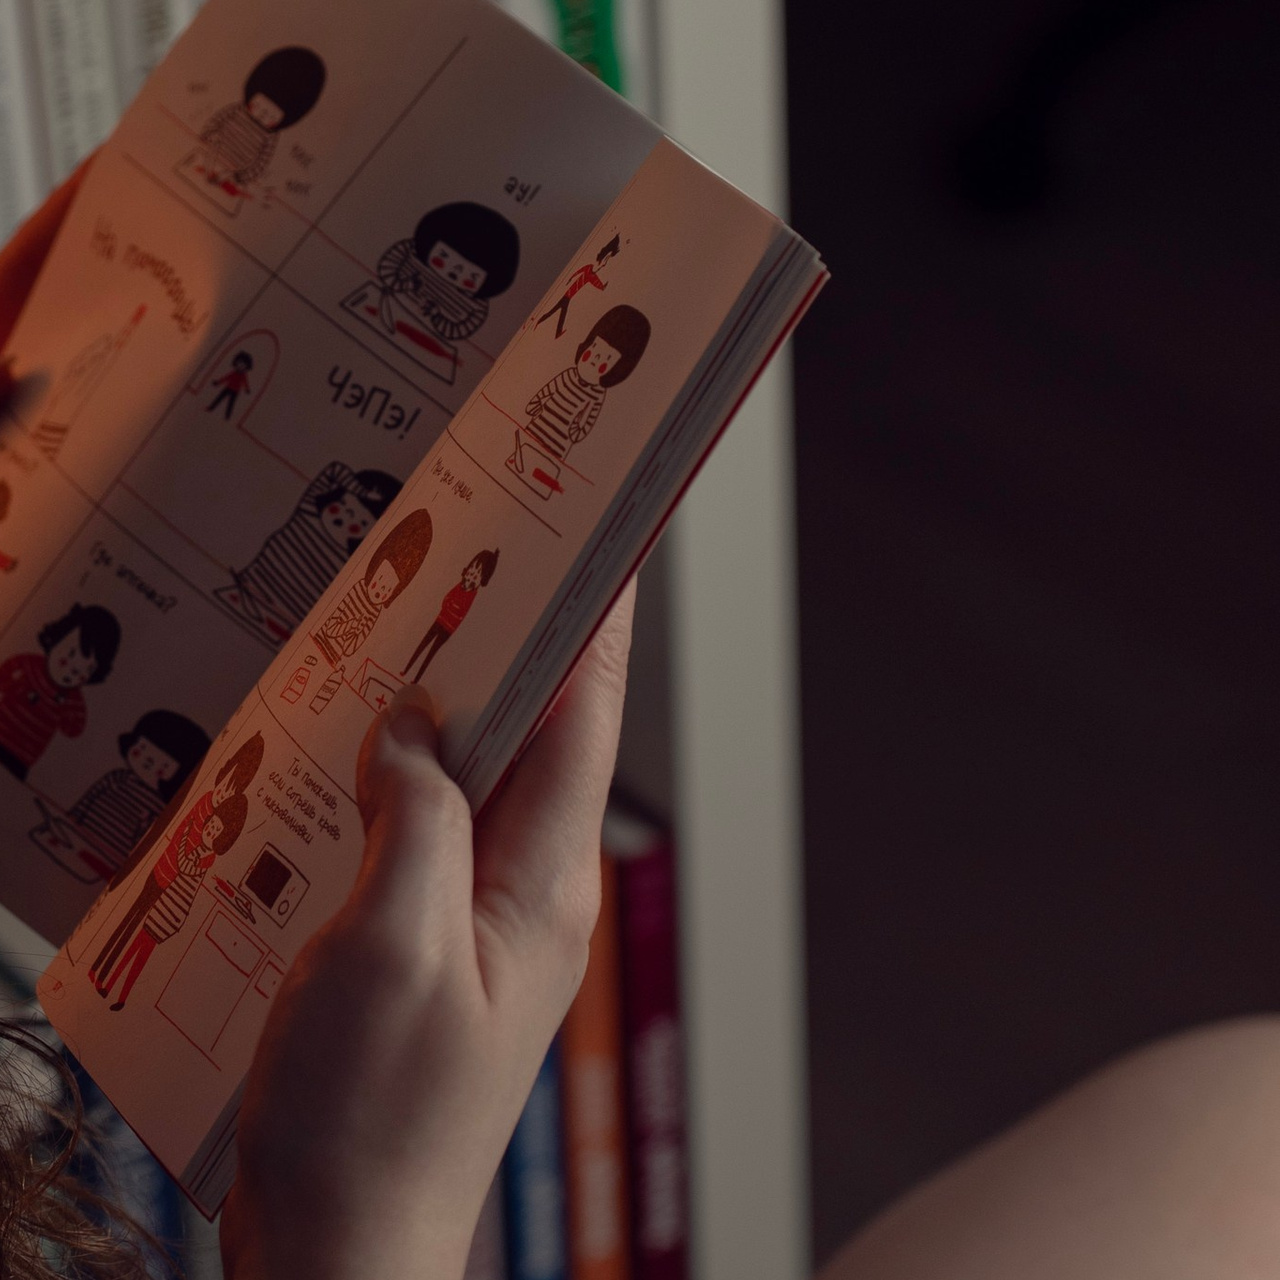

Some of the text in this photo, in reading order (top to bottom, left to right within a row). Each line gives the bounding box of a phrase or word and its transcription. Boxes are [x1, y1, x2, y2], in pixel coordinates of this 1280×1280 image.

[256, 787, 314, 845] с микроволновки
[268, 771, 286, 792] если
[317, 815, 341, 841] кровь
[287, 757, 337, 816] Ты поможешь,
